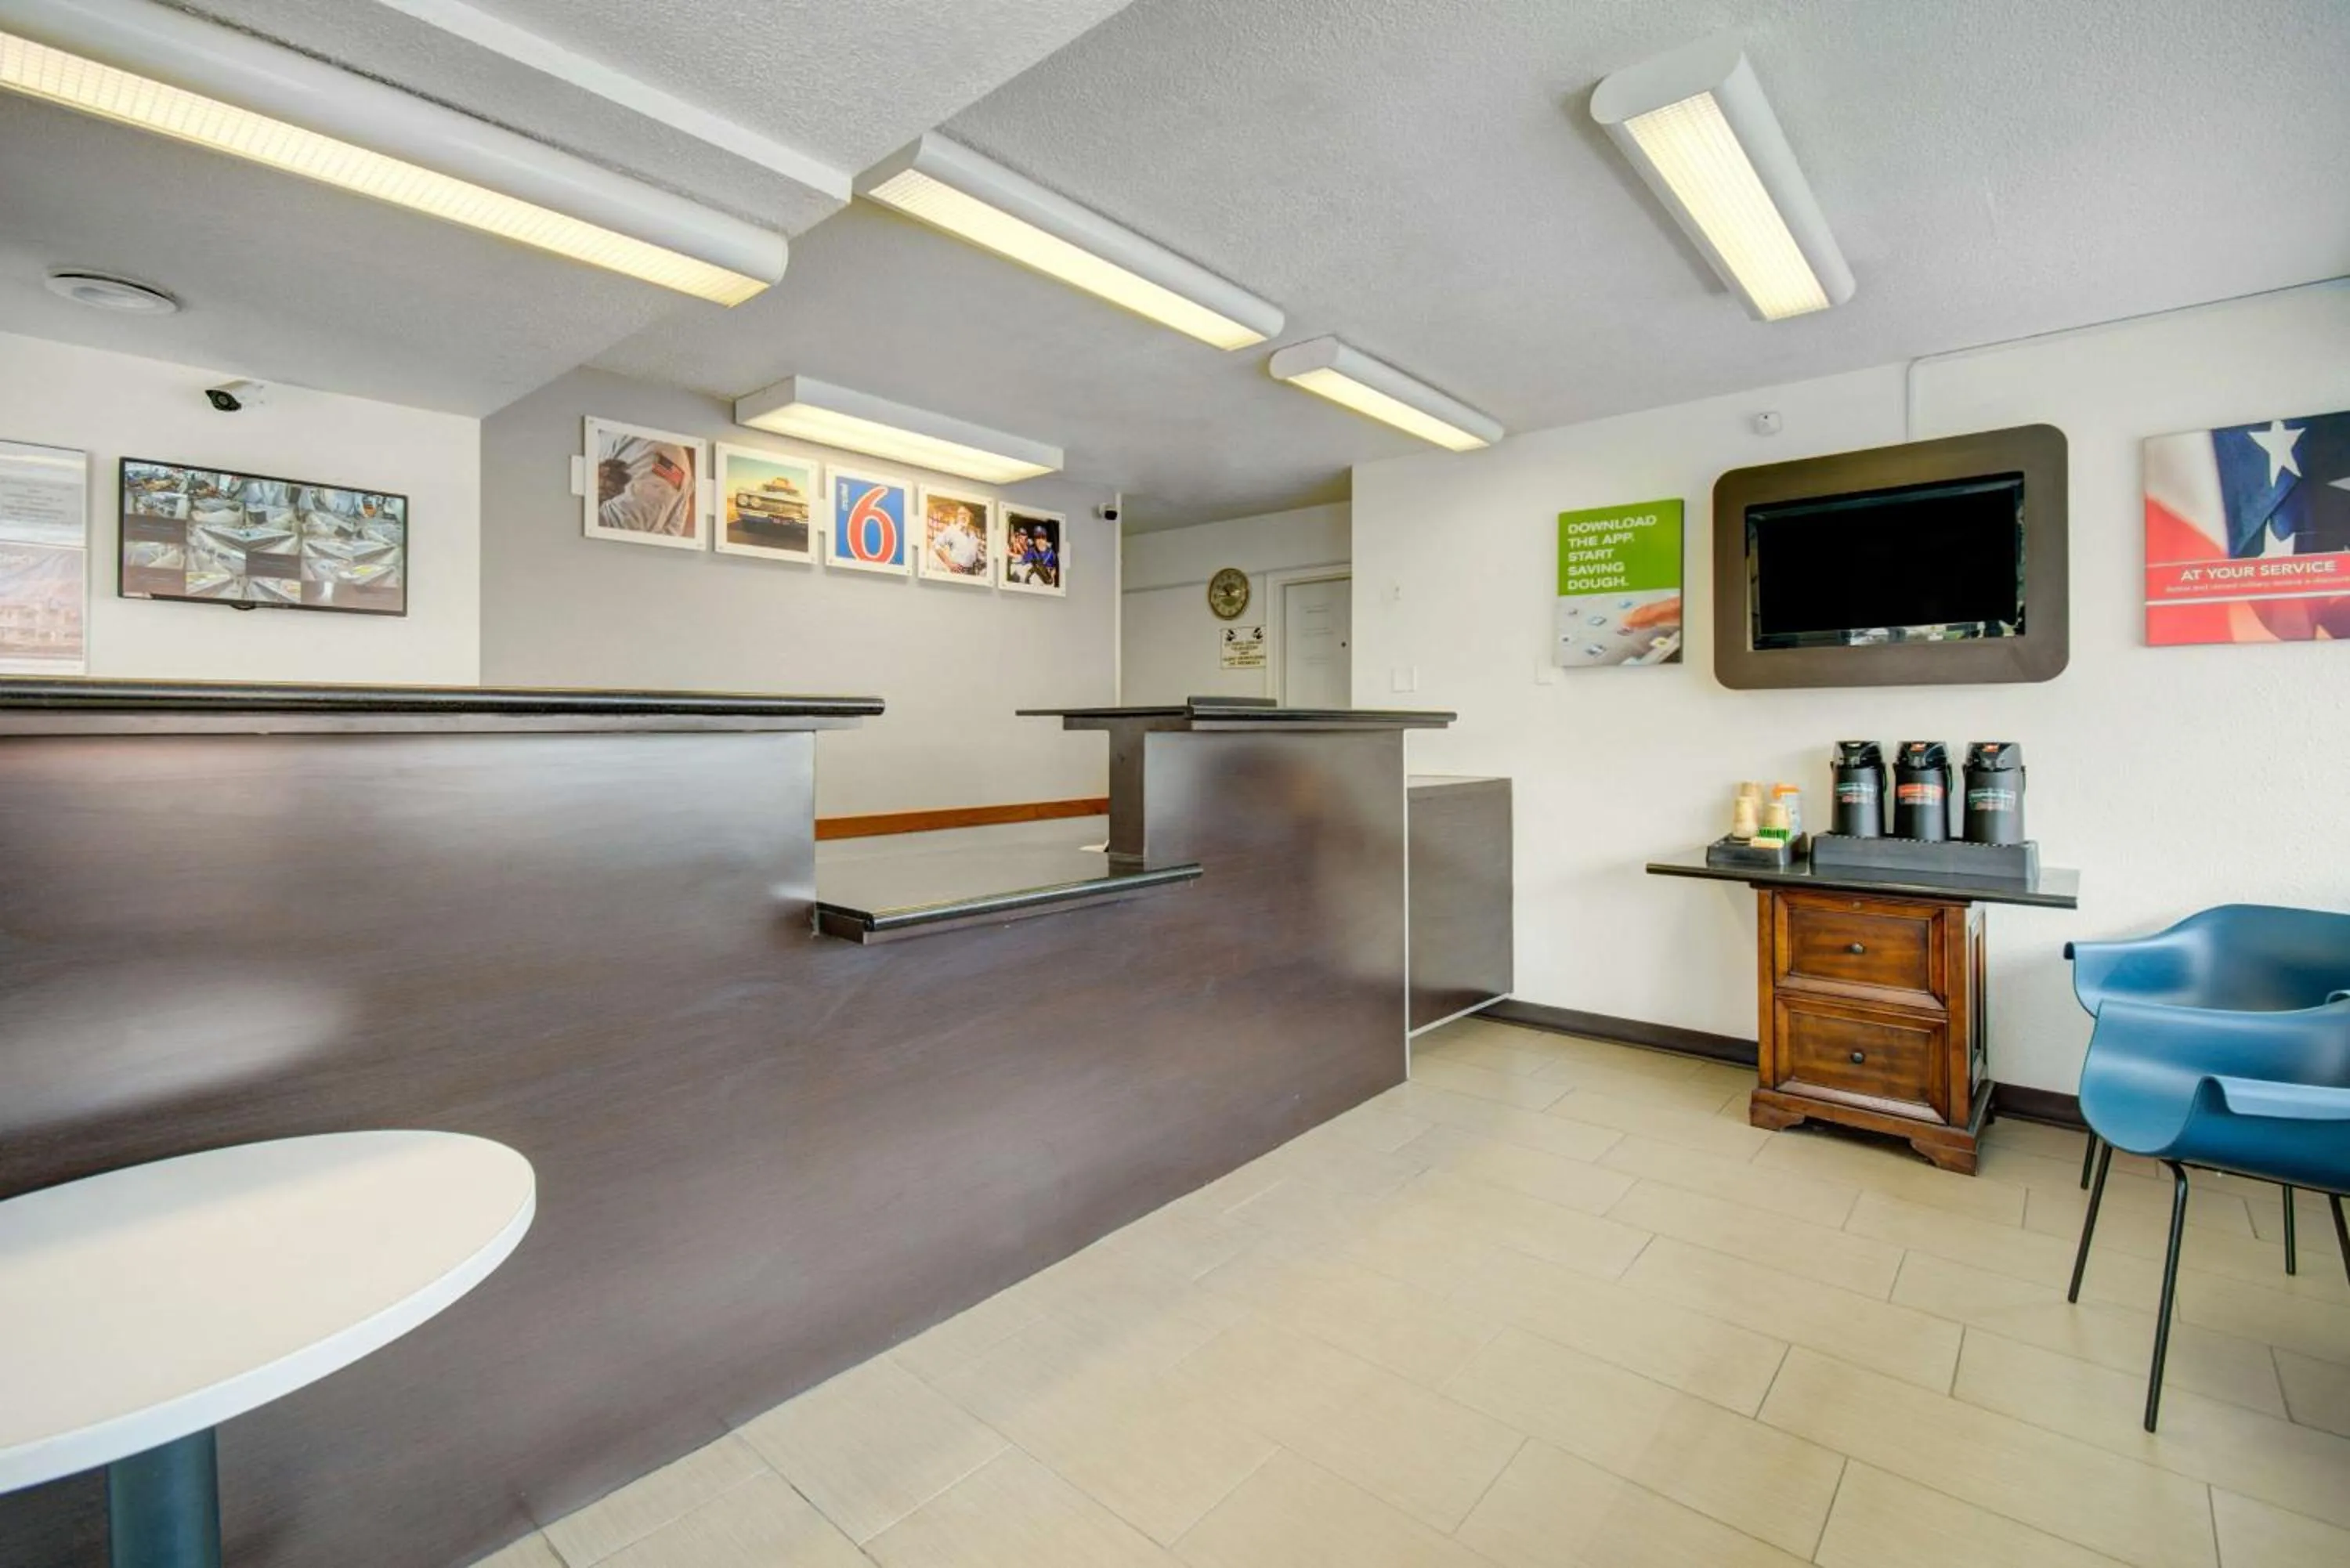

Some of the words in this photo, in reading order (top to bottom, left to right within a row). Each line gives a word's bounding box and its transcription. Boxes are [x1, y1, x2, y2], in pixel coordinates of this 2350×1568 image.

[848, 486, 897, 564] 6
[1568, 515, 1657, 534] DOWNLOAD
[1568, 536, 1598, 548] THE
[1568, 548, 1614, 562] START
[1568, 562, 1625, 576] SAVING
[2181, 569, 2201, 582] AT
[2207, 565, 2254, 580] YOUR
[2260, 560, 2337, 576] SERVICE
[1568, 576, 1629, 590] DOUGH.
